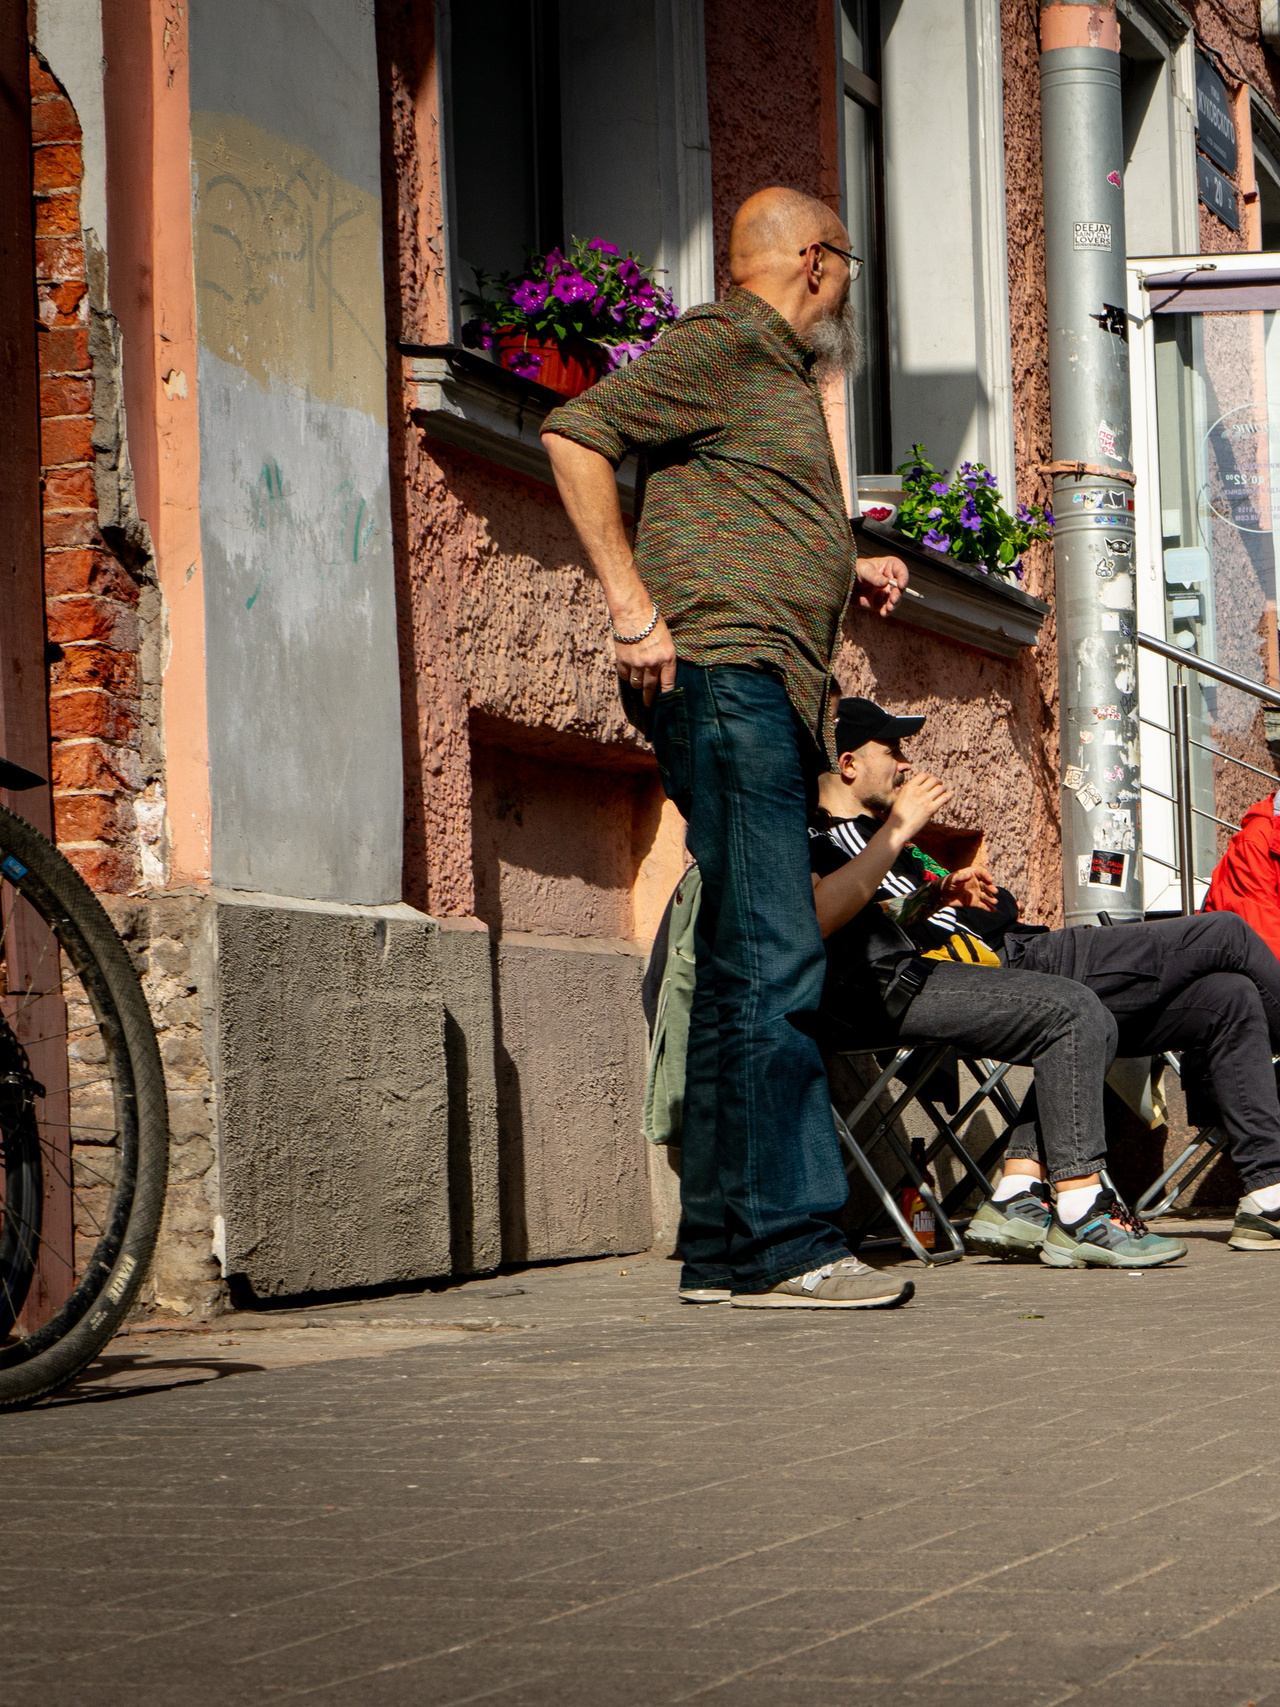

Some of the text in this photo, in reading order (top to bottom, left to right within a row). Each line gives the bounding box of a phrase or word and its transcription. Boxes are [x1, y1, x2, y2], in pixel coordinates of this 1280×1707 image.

[1214, 177, 1223, 207] 20
[1075, 223, 1110, 233] DEEJAY
[1075, 237, 1110, 245] LOVERS
